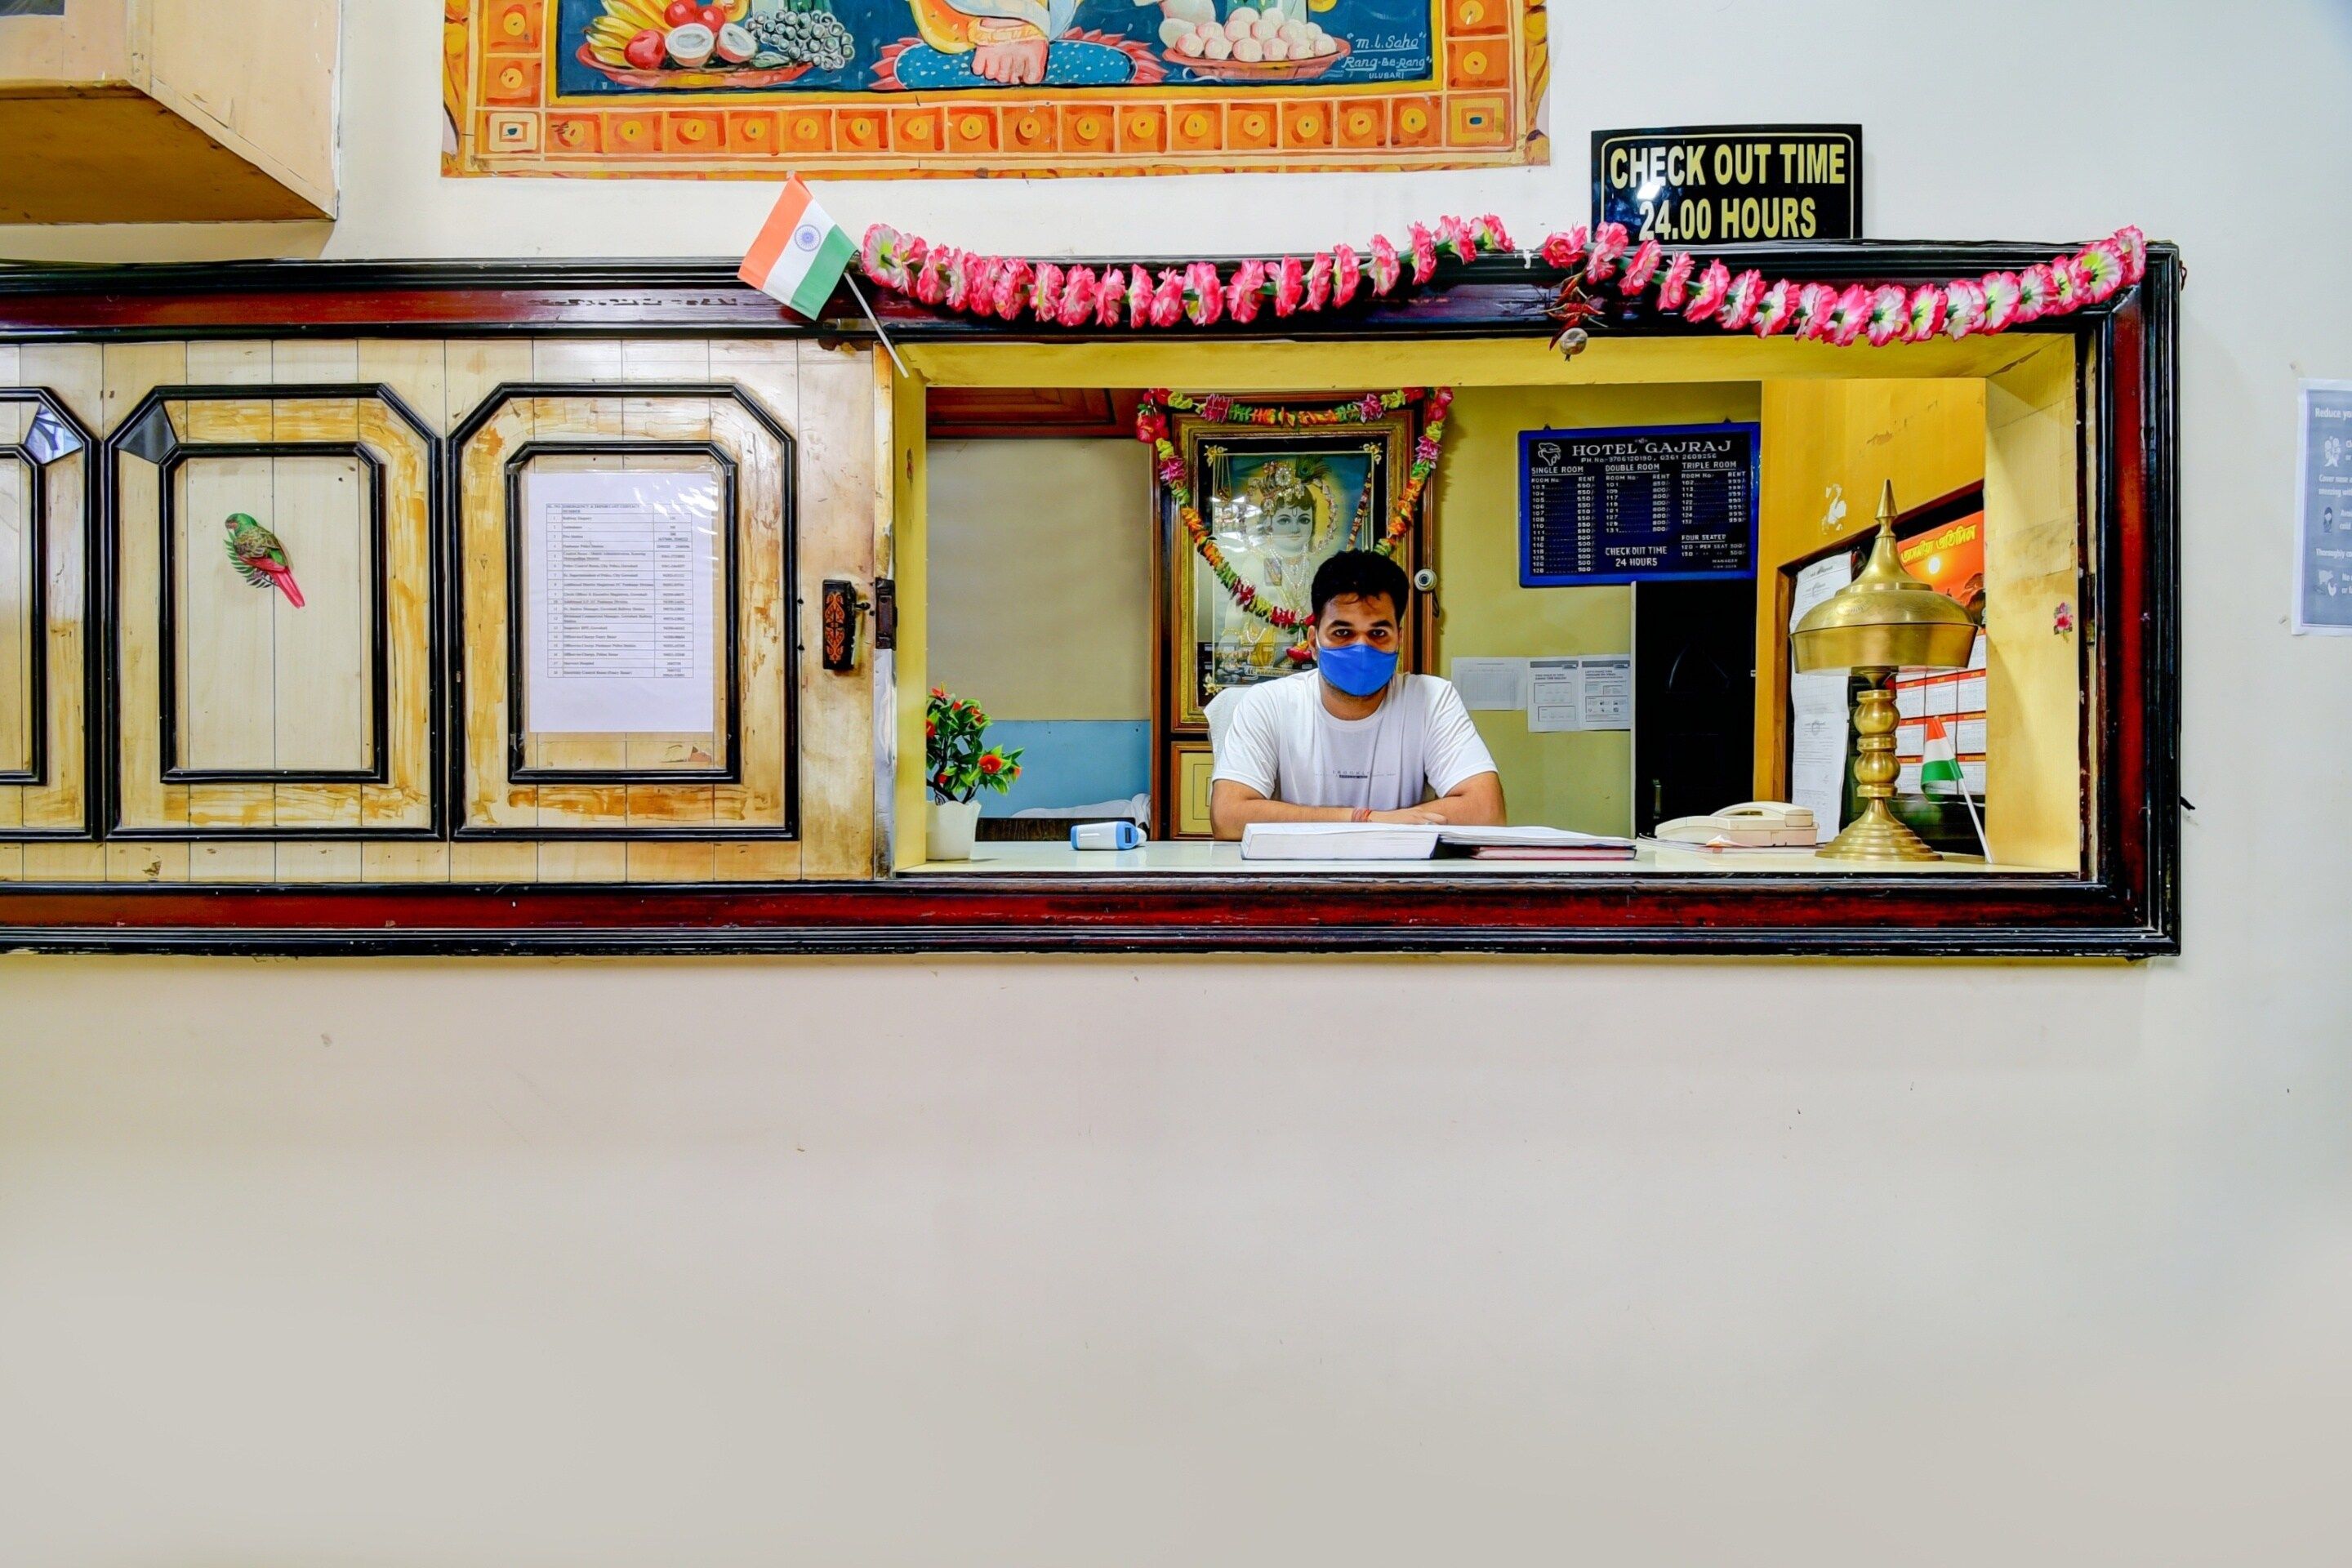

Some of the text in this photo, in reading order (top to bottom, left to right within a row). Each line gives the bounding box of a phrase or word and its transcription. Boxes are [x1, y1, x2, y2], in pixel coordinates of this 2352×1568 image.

[1610, 144, 1845, 189] CHECK OUT TIME
[1638, 197, 1815, 241] 24.00 HOURS
[2315, 408, 2341, 417] Reduce
[1572, 443, 1637, 457] HOTEL
[1645, 440, 1731, 453] GAJRAJ
[1606, 547, 1630, 555] CHECK
[1648, 546, 1668, 555] TIME
[1615, 558, 1657, 567] 24 HOURS
